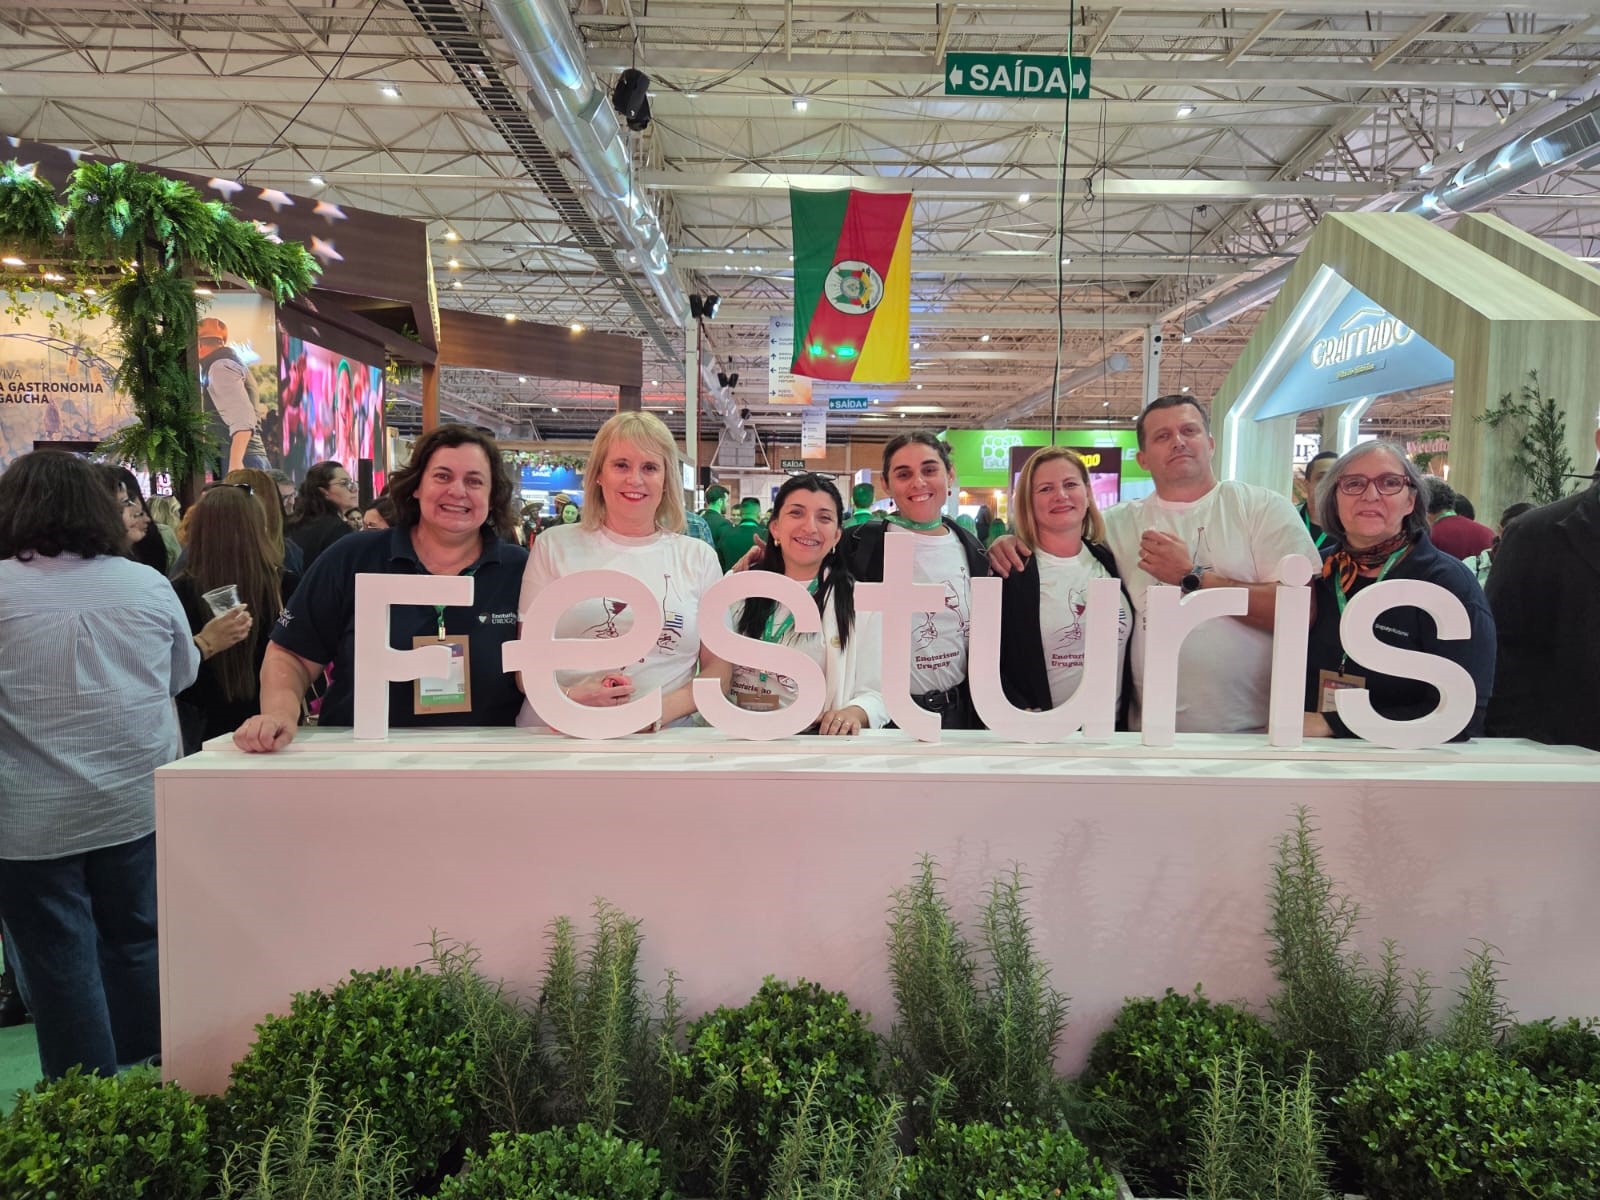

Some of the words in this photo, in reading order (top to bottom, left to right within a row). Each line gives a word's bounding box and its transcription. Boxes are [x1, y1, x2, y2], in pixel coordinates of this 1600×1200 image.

[968, 59, 1068, 94] SAÍDA
[8, 382, 104, 393] GASTRONOMIA
[835, 400, 862, 409] SAÍDA
[782, 460, 804, 468] SAÍDA
[353, 532, 1477, 750] Festuris
[916, 661, 951, 670] Uruguay
[1051, 660, 1084, 668] Urugua
